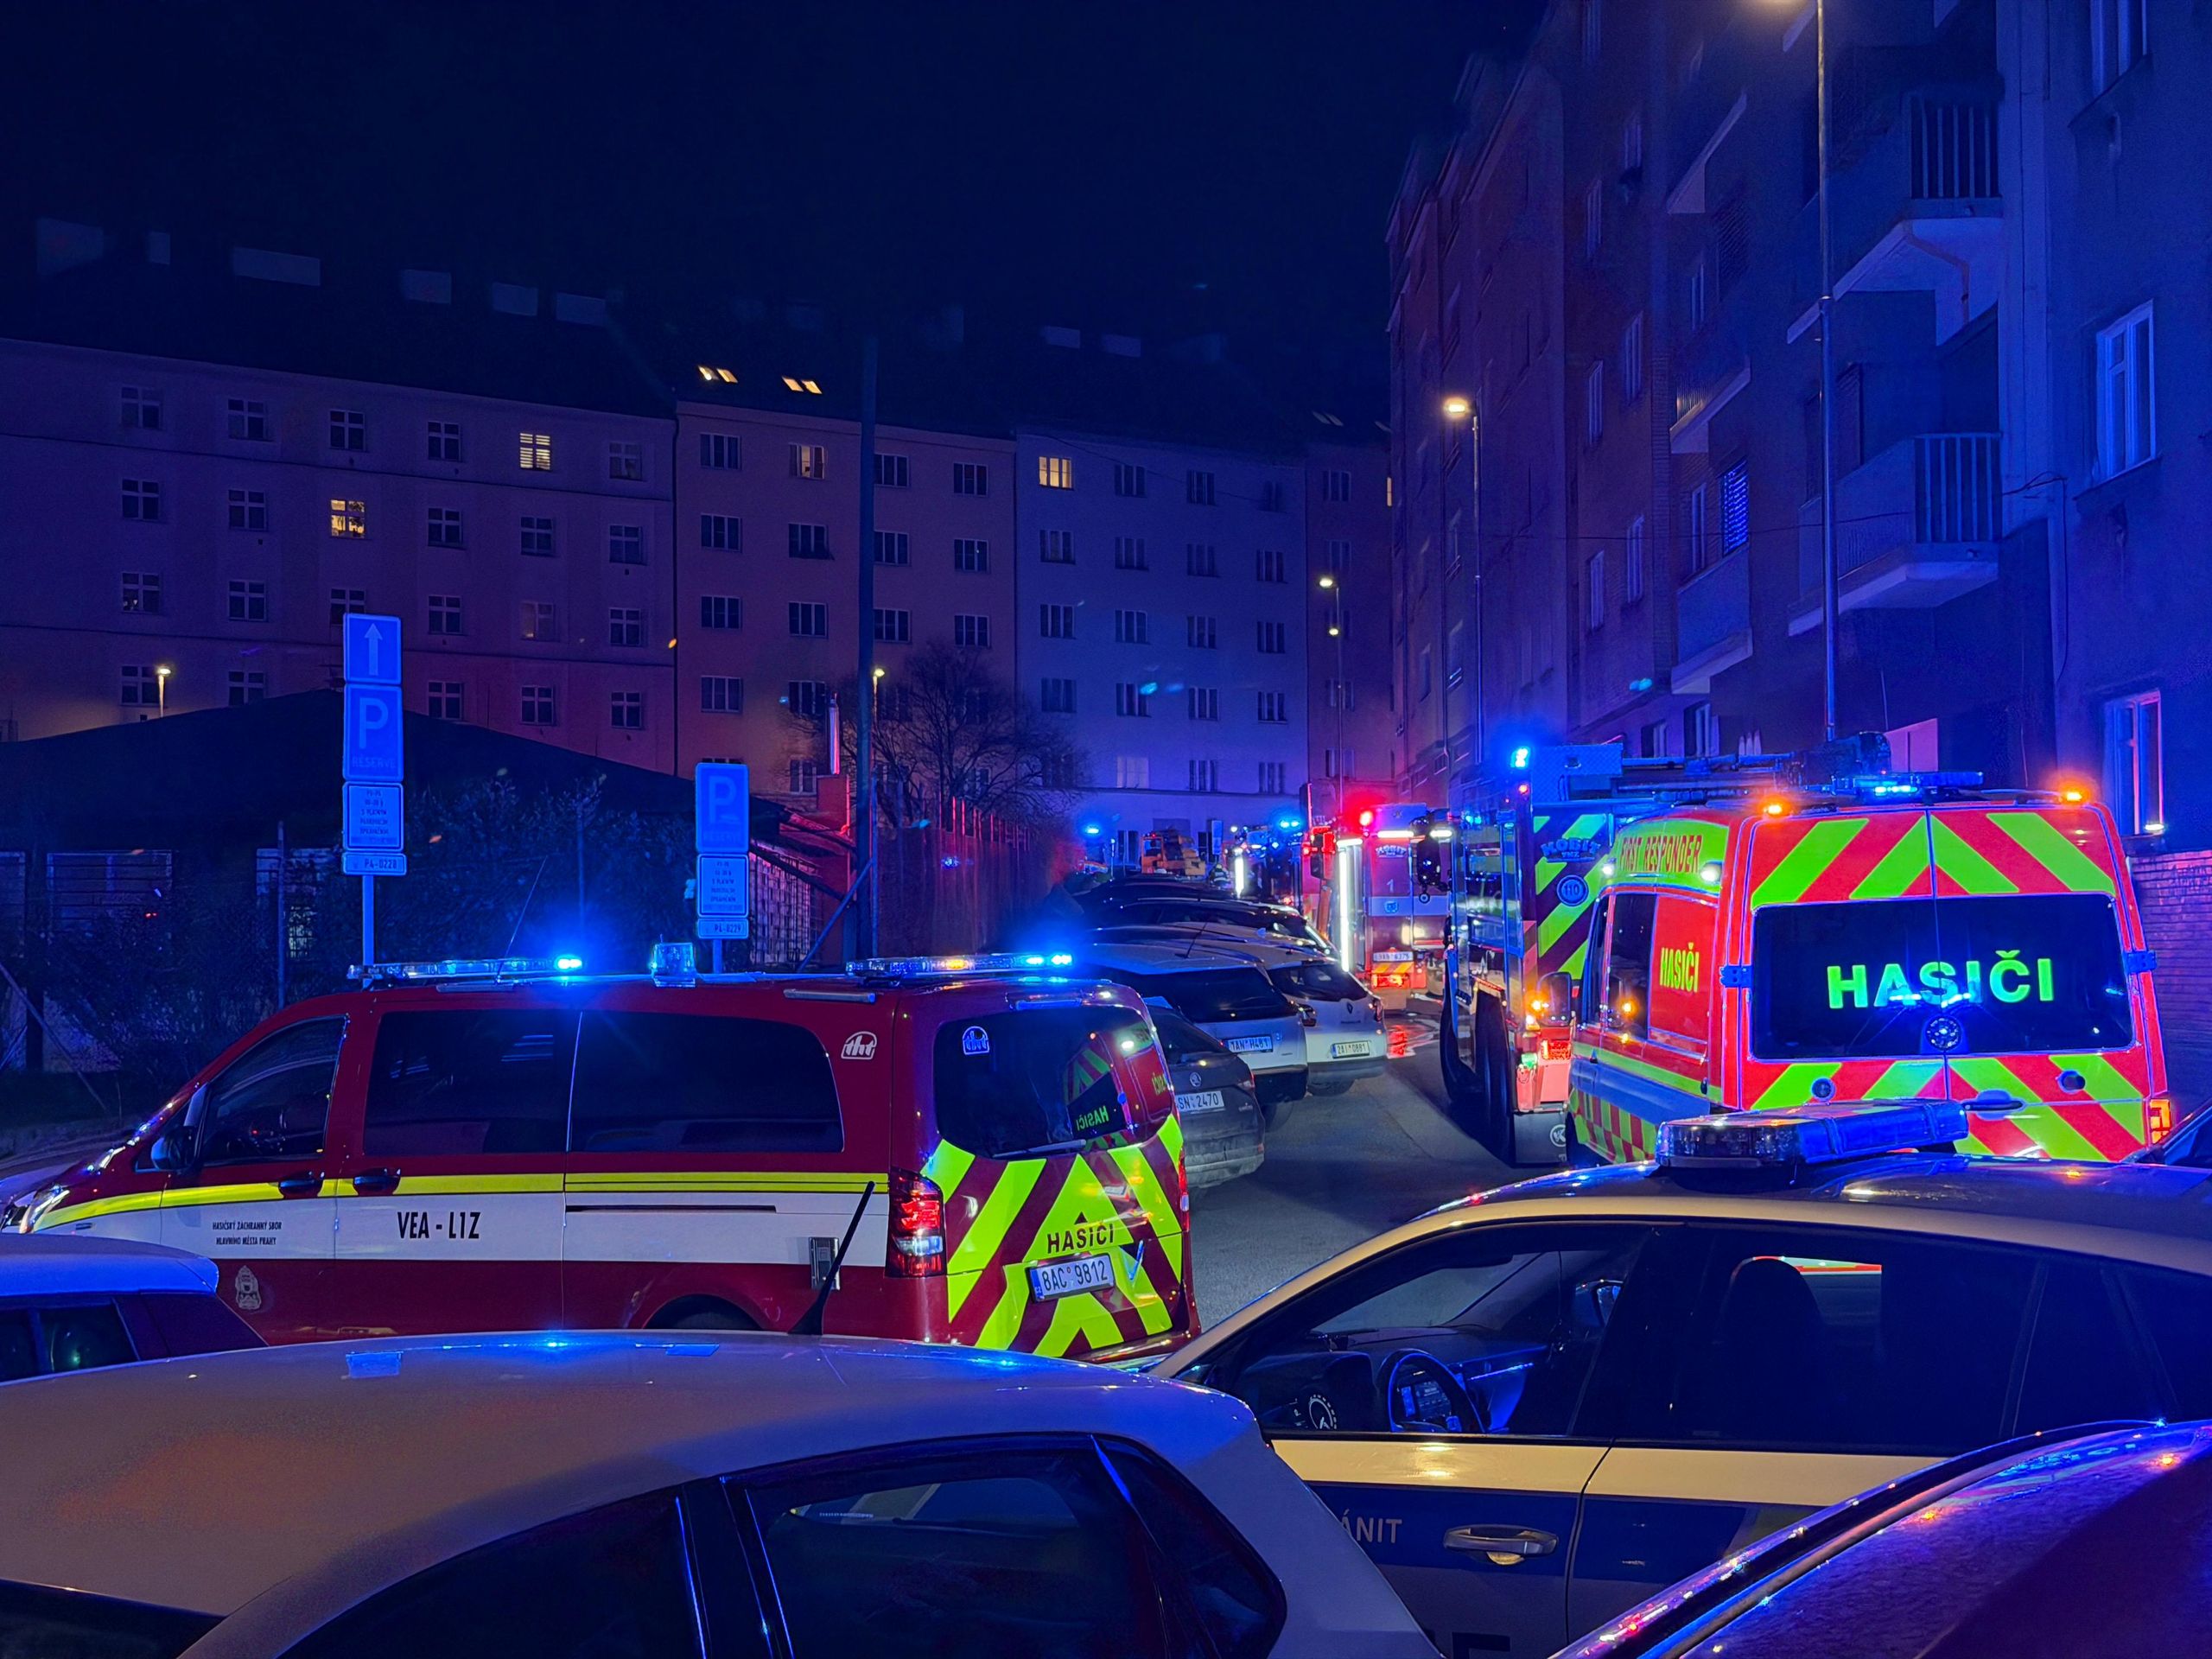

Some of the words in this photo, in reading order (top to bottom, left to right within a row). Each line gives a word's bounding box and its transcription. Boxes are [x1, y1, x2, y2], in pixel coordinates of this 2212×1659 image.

[359, 697, 388, 749] P
[709, 776, 736, 823] P
[1620, 837, 1642, 871] FIRST
[1643, 835, 1702, 873] RESPONDER
[1387, 878, 1394, 893] 1
[1660, 942, 1699, 993] HASIČI
[1827, 950, 2054, 1008] HASIČI
[1176, 1096, 1191, 1110] SN
[1196, 1093, 1219, 1108] 2470
[269, 1221, 282, 1230] SBOR
[397, 1211, 429, 1239] VEA
[448, 1211, 481, 1239] L1Z
[1041, 1267, 1067, 1292] 8AC
[1074, 1260, 1108, 1286] 9812
